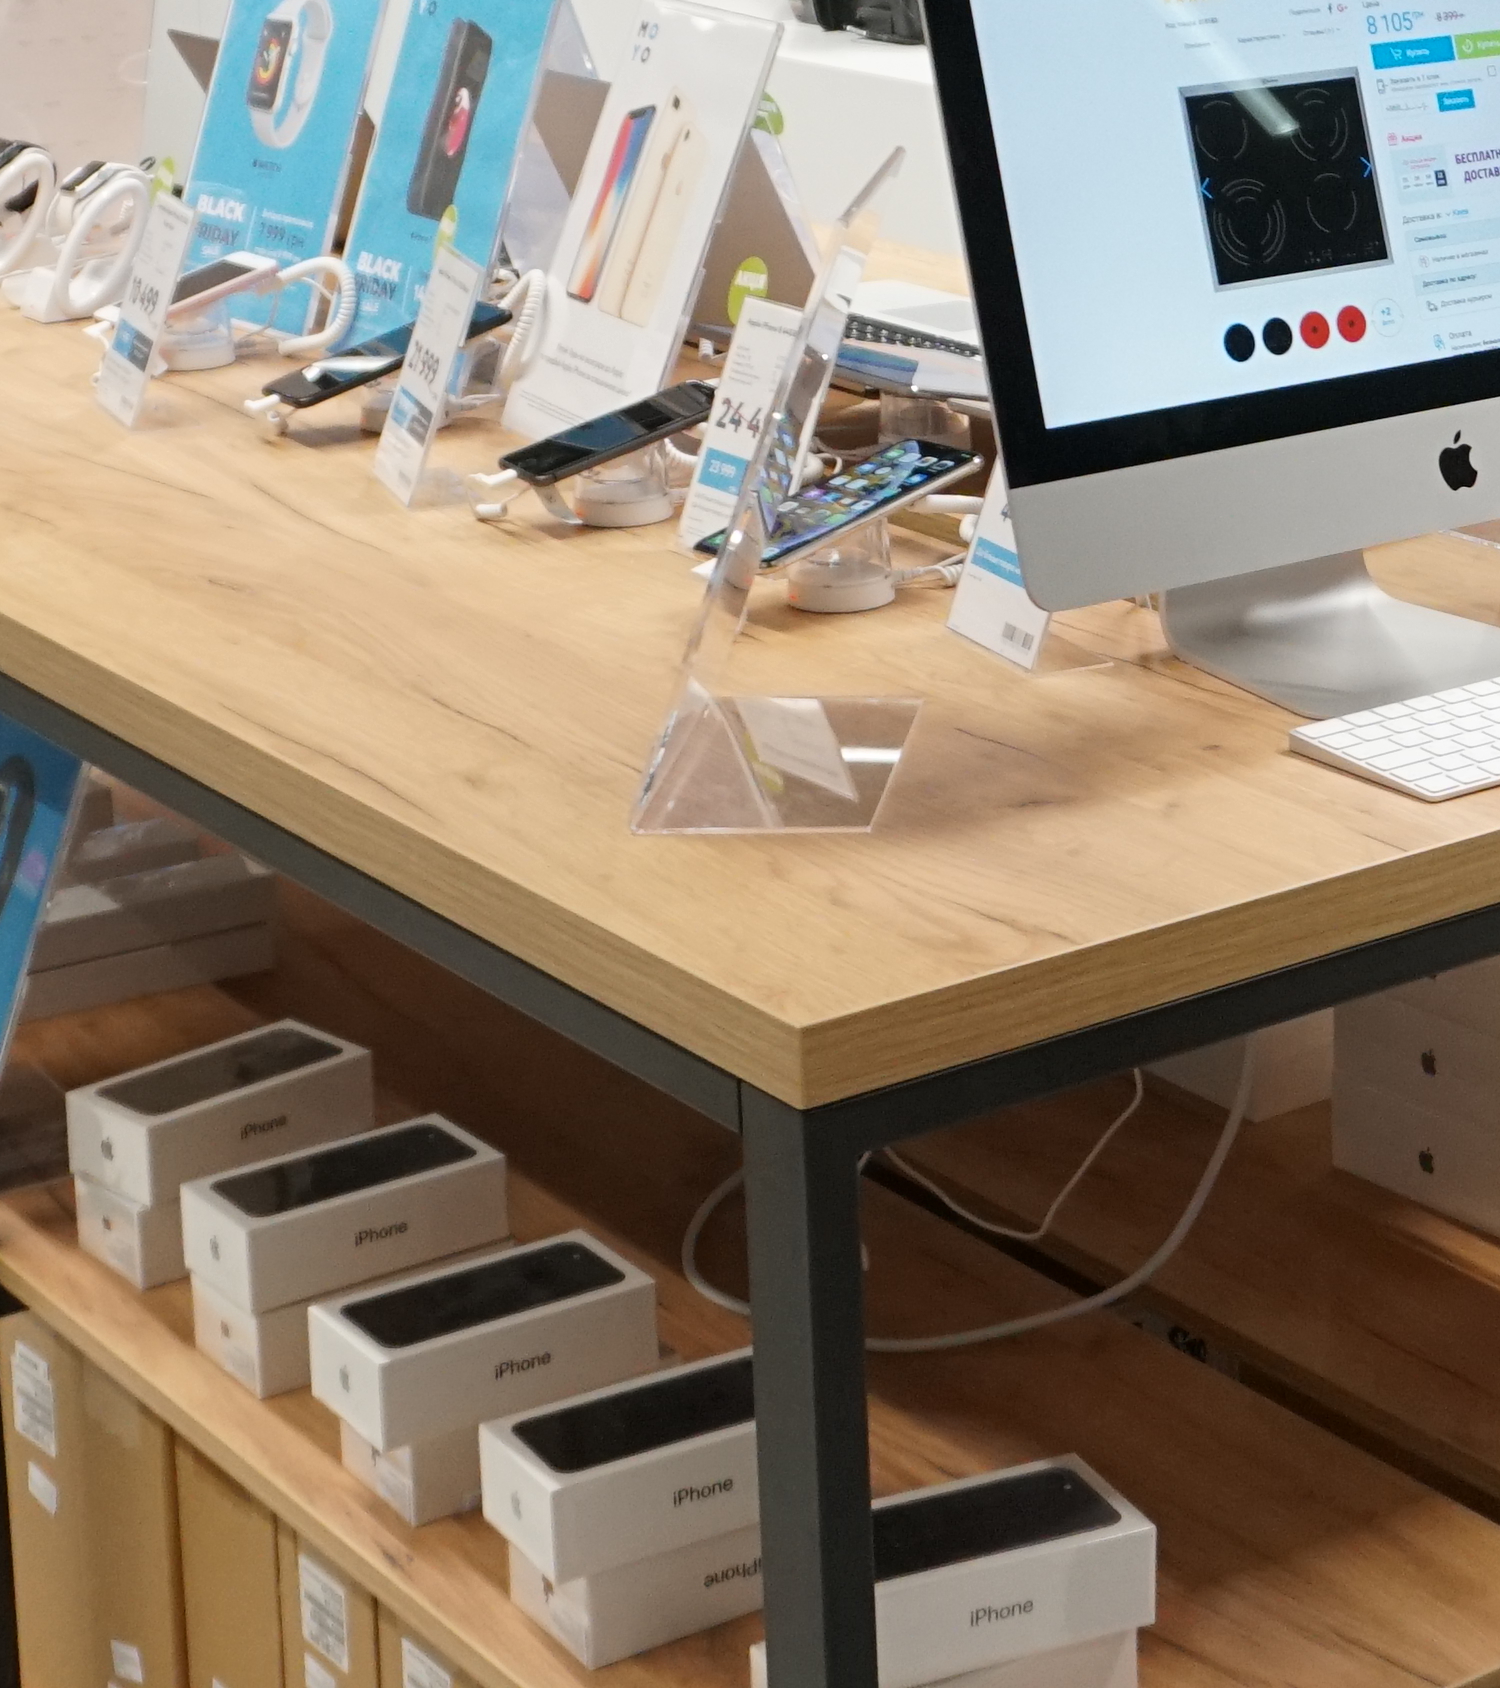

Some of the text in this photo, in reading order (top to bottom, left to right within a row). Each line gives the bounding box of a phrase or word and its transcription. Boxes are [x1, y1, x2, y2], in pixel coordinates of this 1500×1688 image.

[1366, 15, 1378, 35] 8
[1384, 12, 1414, 34] 105
[196, 193, 247, 223] BLACK
[357, 251, 403, 282] BLACK
[715, 396, 744, 434] 24
[239, 1114, 288, 1141] iPhone
[353, 1221, 409, 1248] iPhone
[494, 1350, 553, 1382] iPhone
[672, 1476, 735, 1509] iPhone
[969, 1598, 1035, 1629] iPhone
